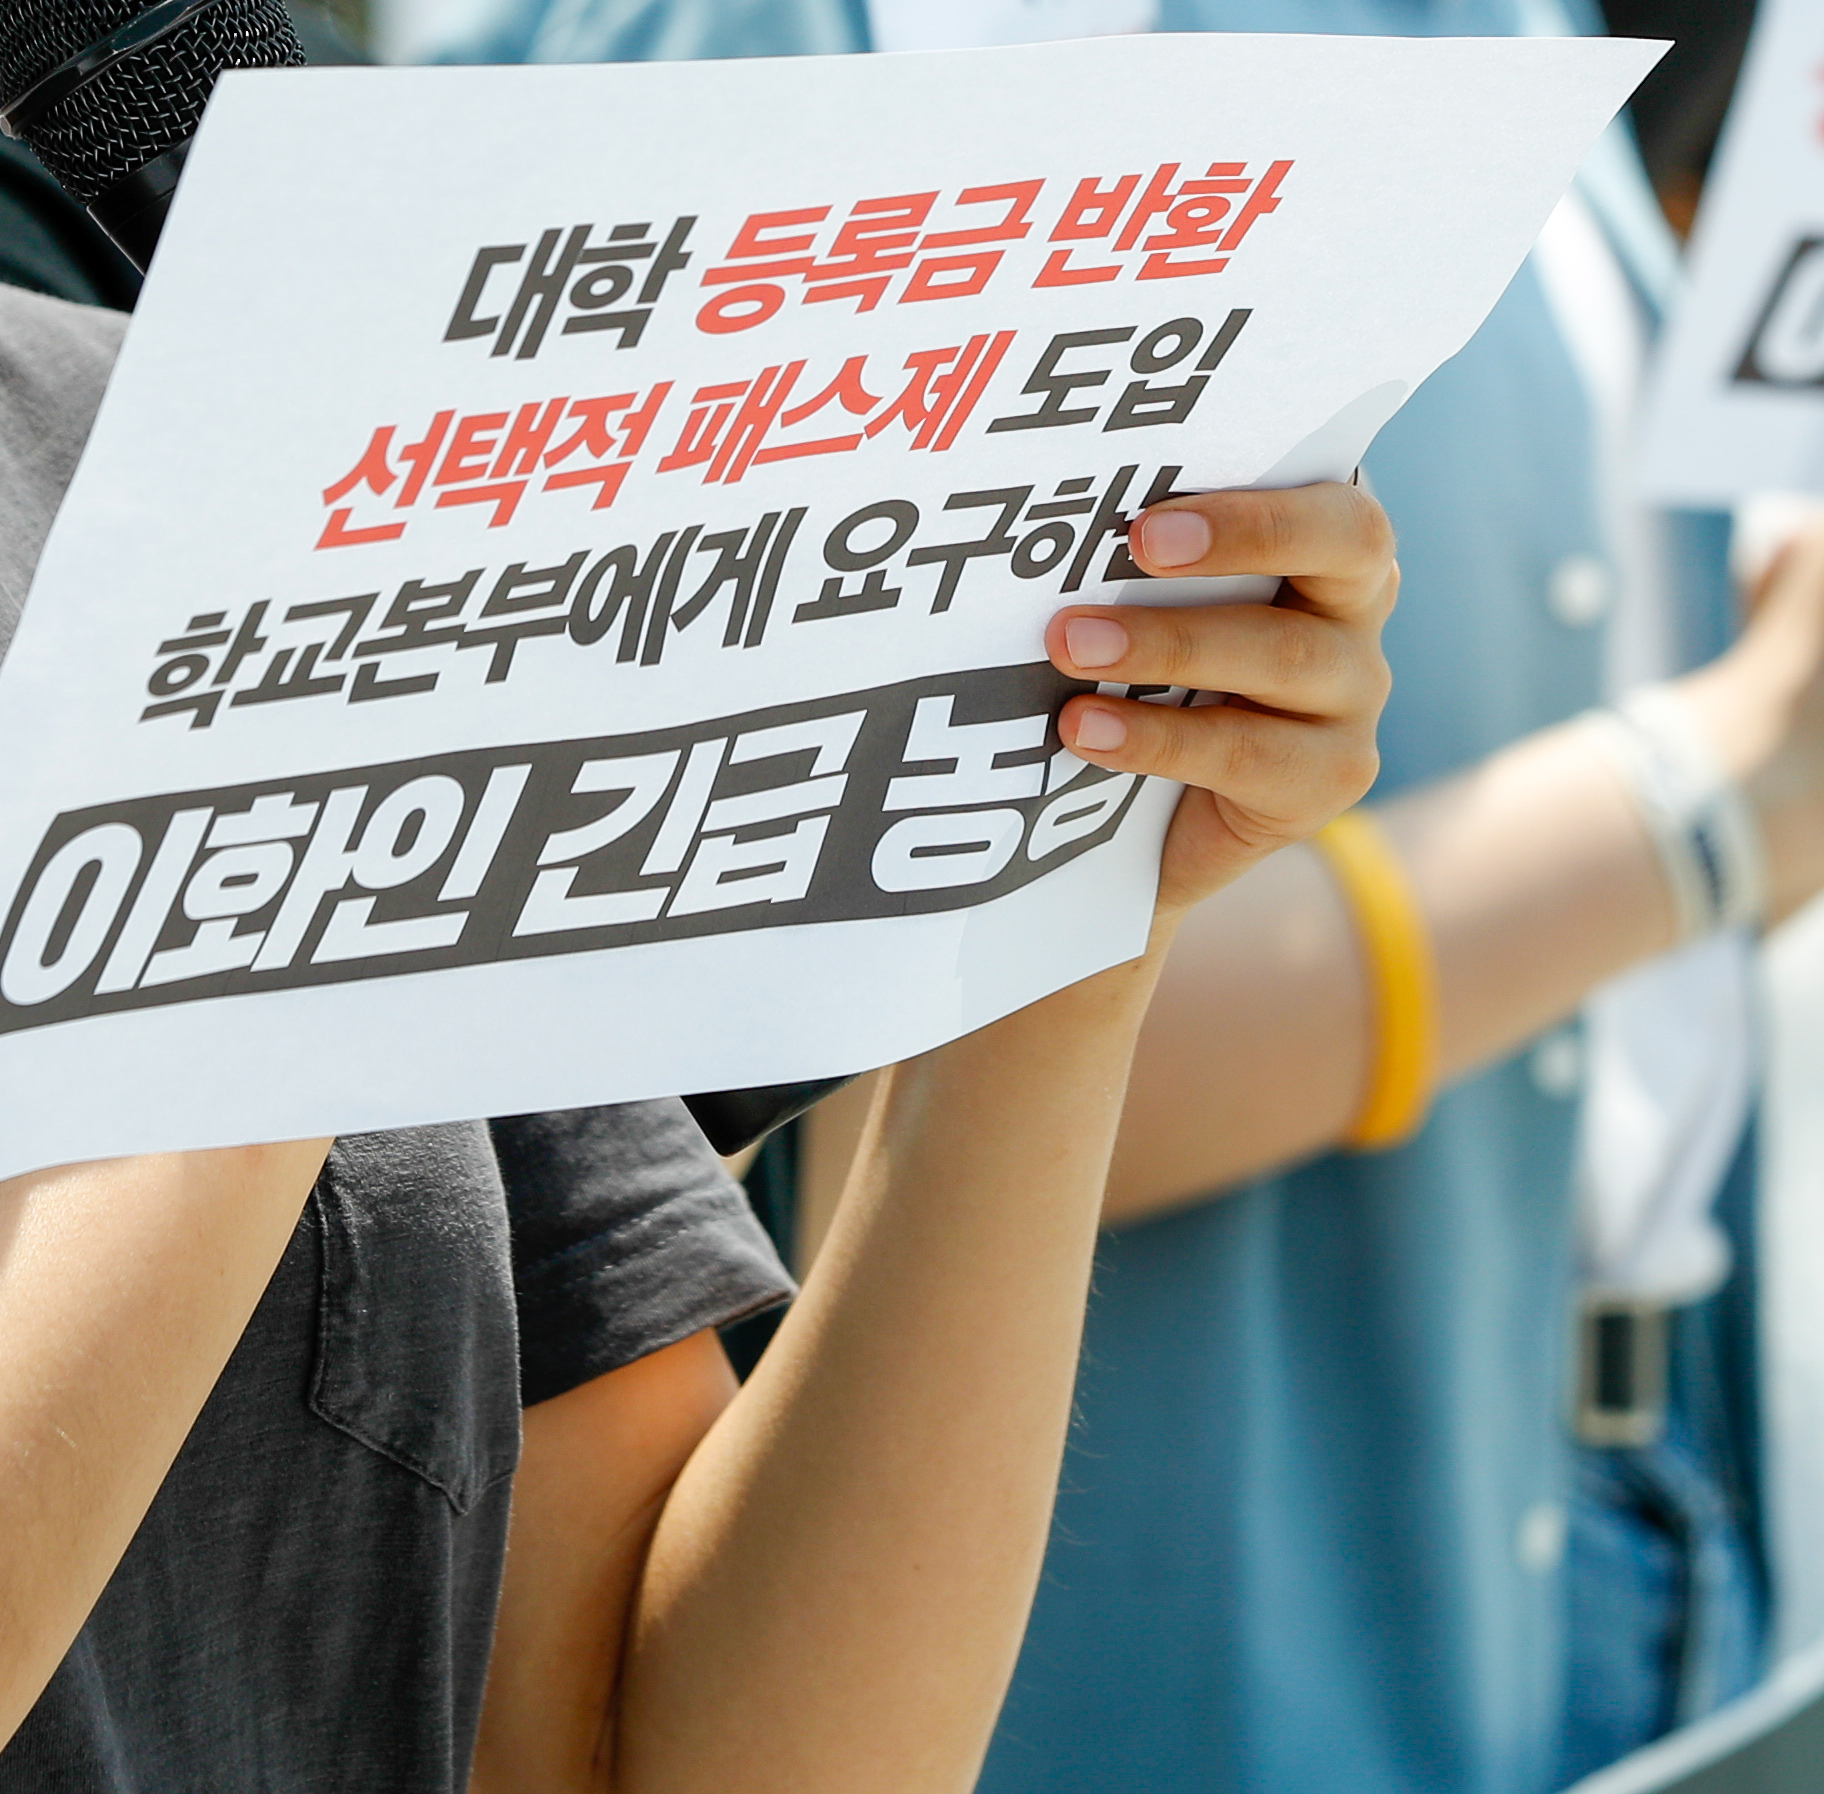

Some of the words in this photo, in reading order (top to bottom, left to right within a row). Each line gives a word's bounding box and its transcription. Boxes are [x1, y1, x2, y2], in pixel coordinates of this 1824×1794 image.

[443, 214, 698, 360] 대학
[695, 177, 1046, 335] 등록금
[1032, 160, 1296, 289] 반환
[315, 380, 675, 549] 선택적
[657, 329, 1018, 487] 패스제
[985, 307, 1255, 436] 도입
[139, 506, 810, 729] 학교본부에게
[0, 761, 533, 1006] 이화인
[512, 708, 870, 938] 긴급
